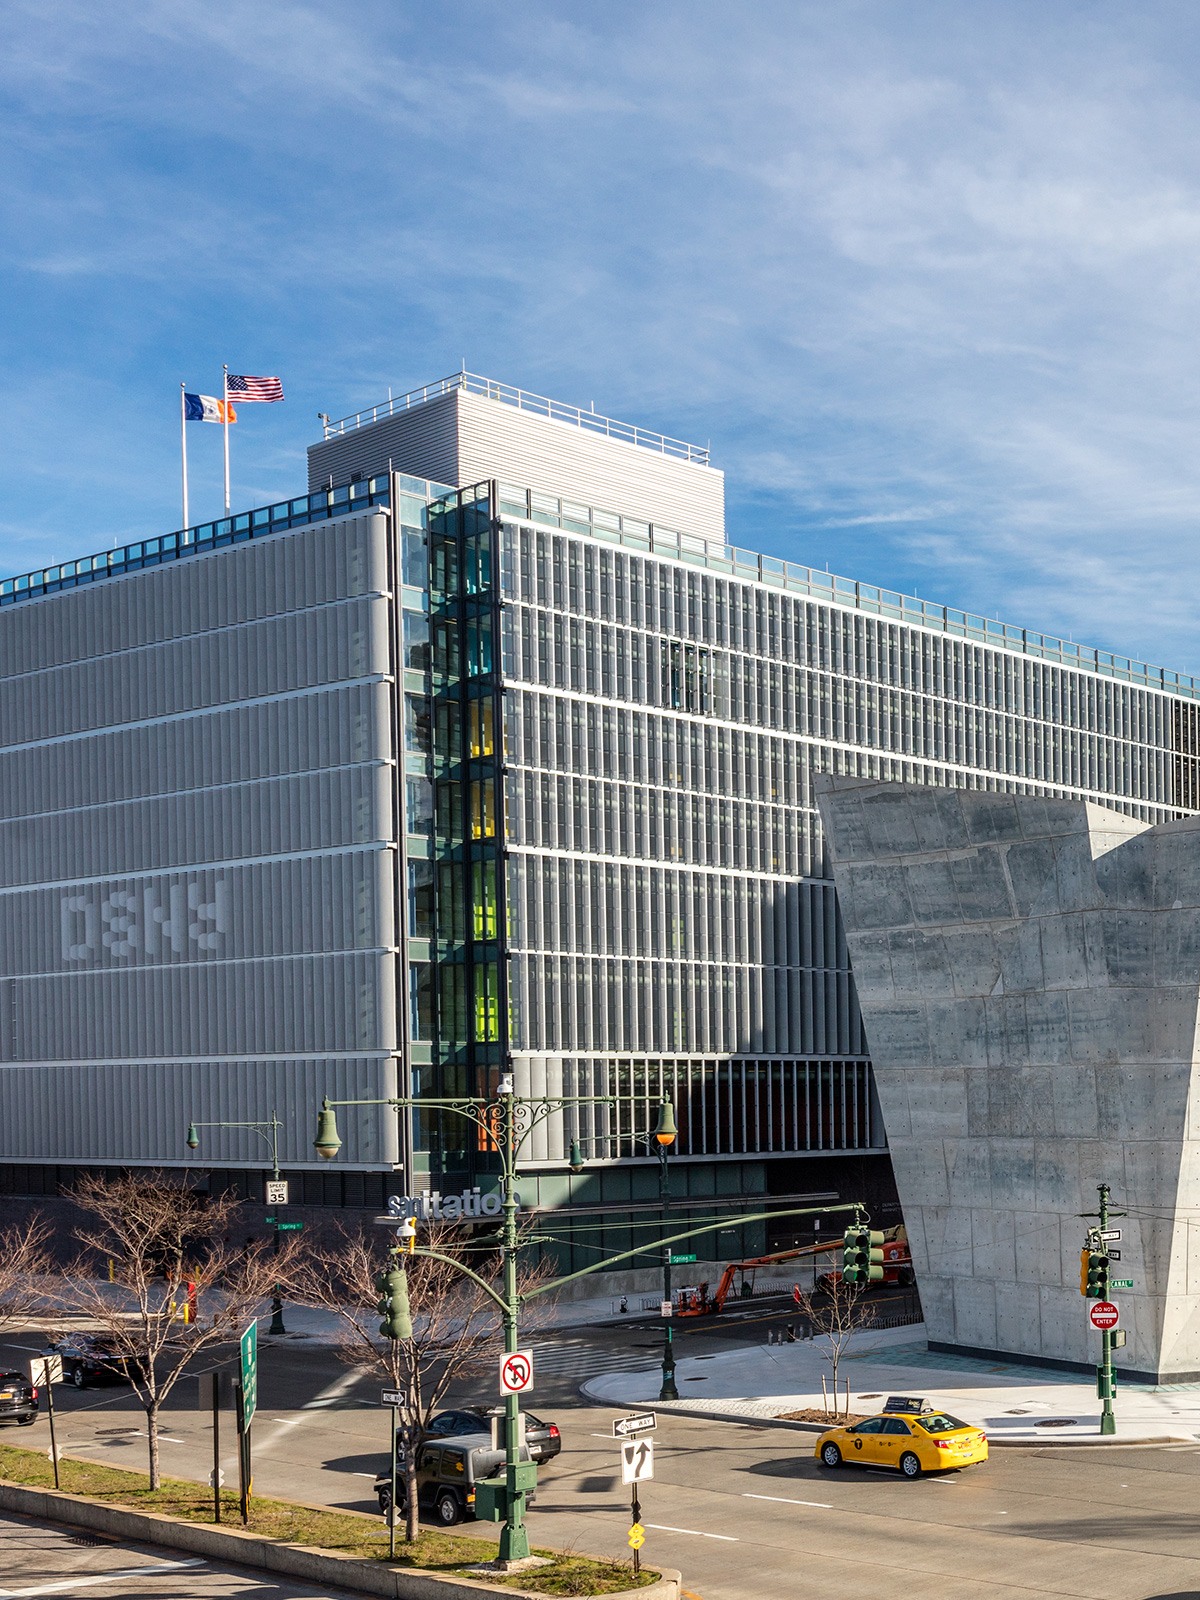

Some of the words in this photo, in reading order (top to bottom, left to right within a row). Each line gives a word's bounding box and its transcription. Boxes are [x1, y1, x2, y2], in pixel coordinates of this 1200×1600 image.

[61, 879, 226, 961] DSNY
[270, 1194, 285, 1202] 35
[620, 1422, 633, 1430] ONE
[638, 1419, 651, 1427] WAY
